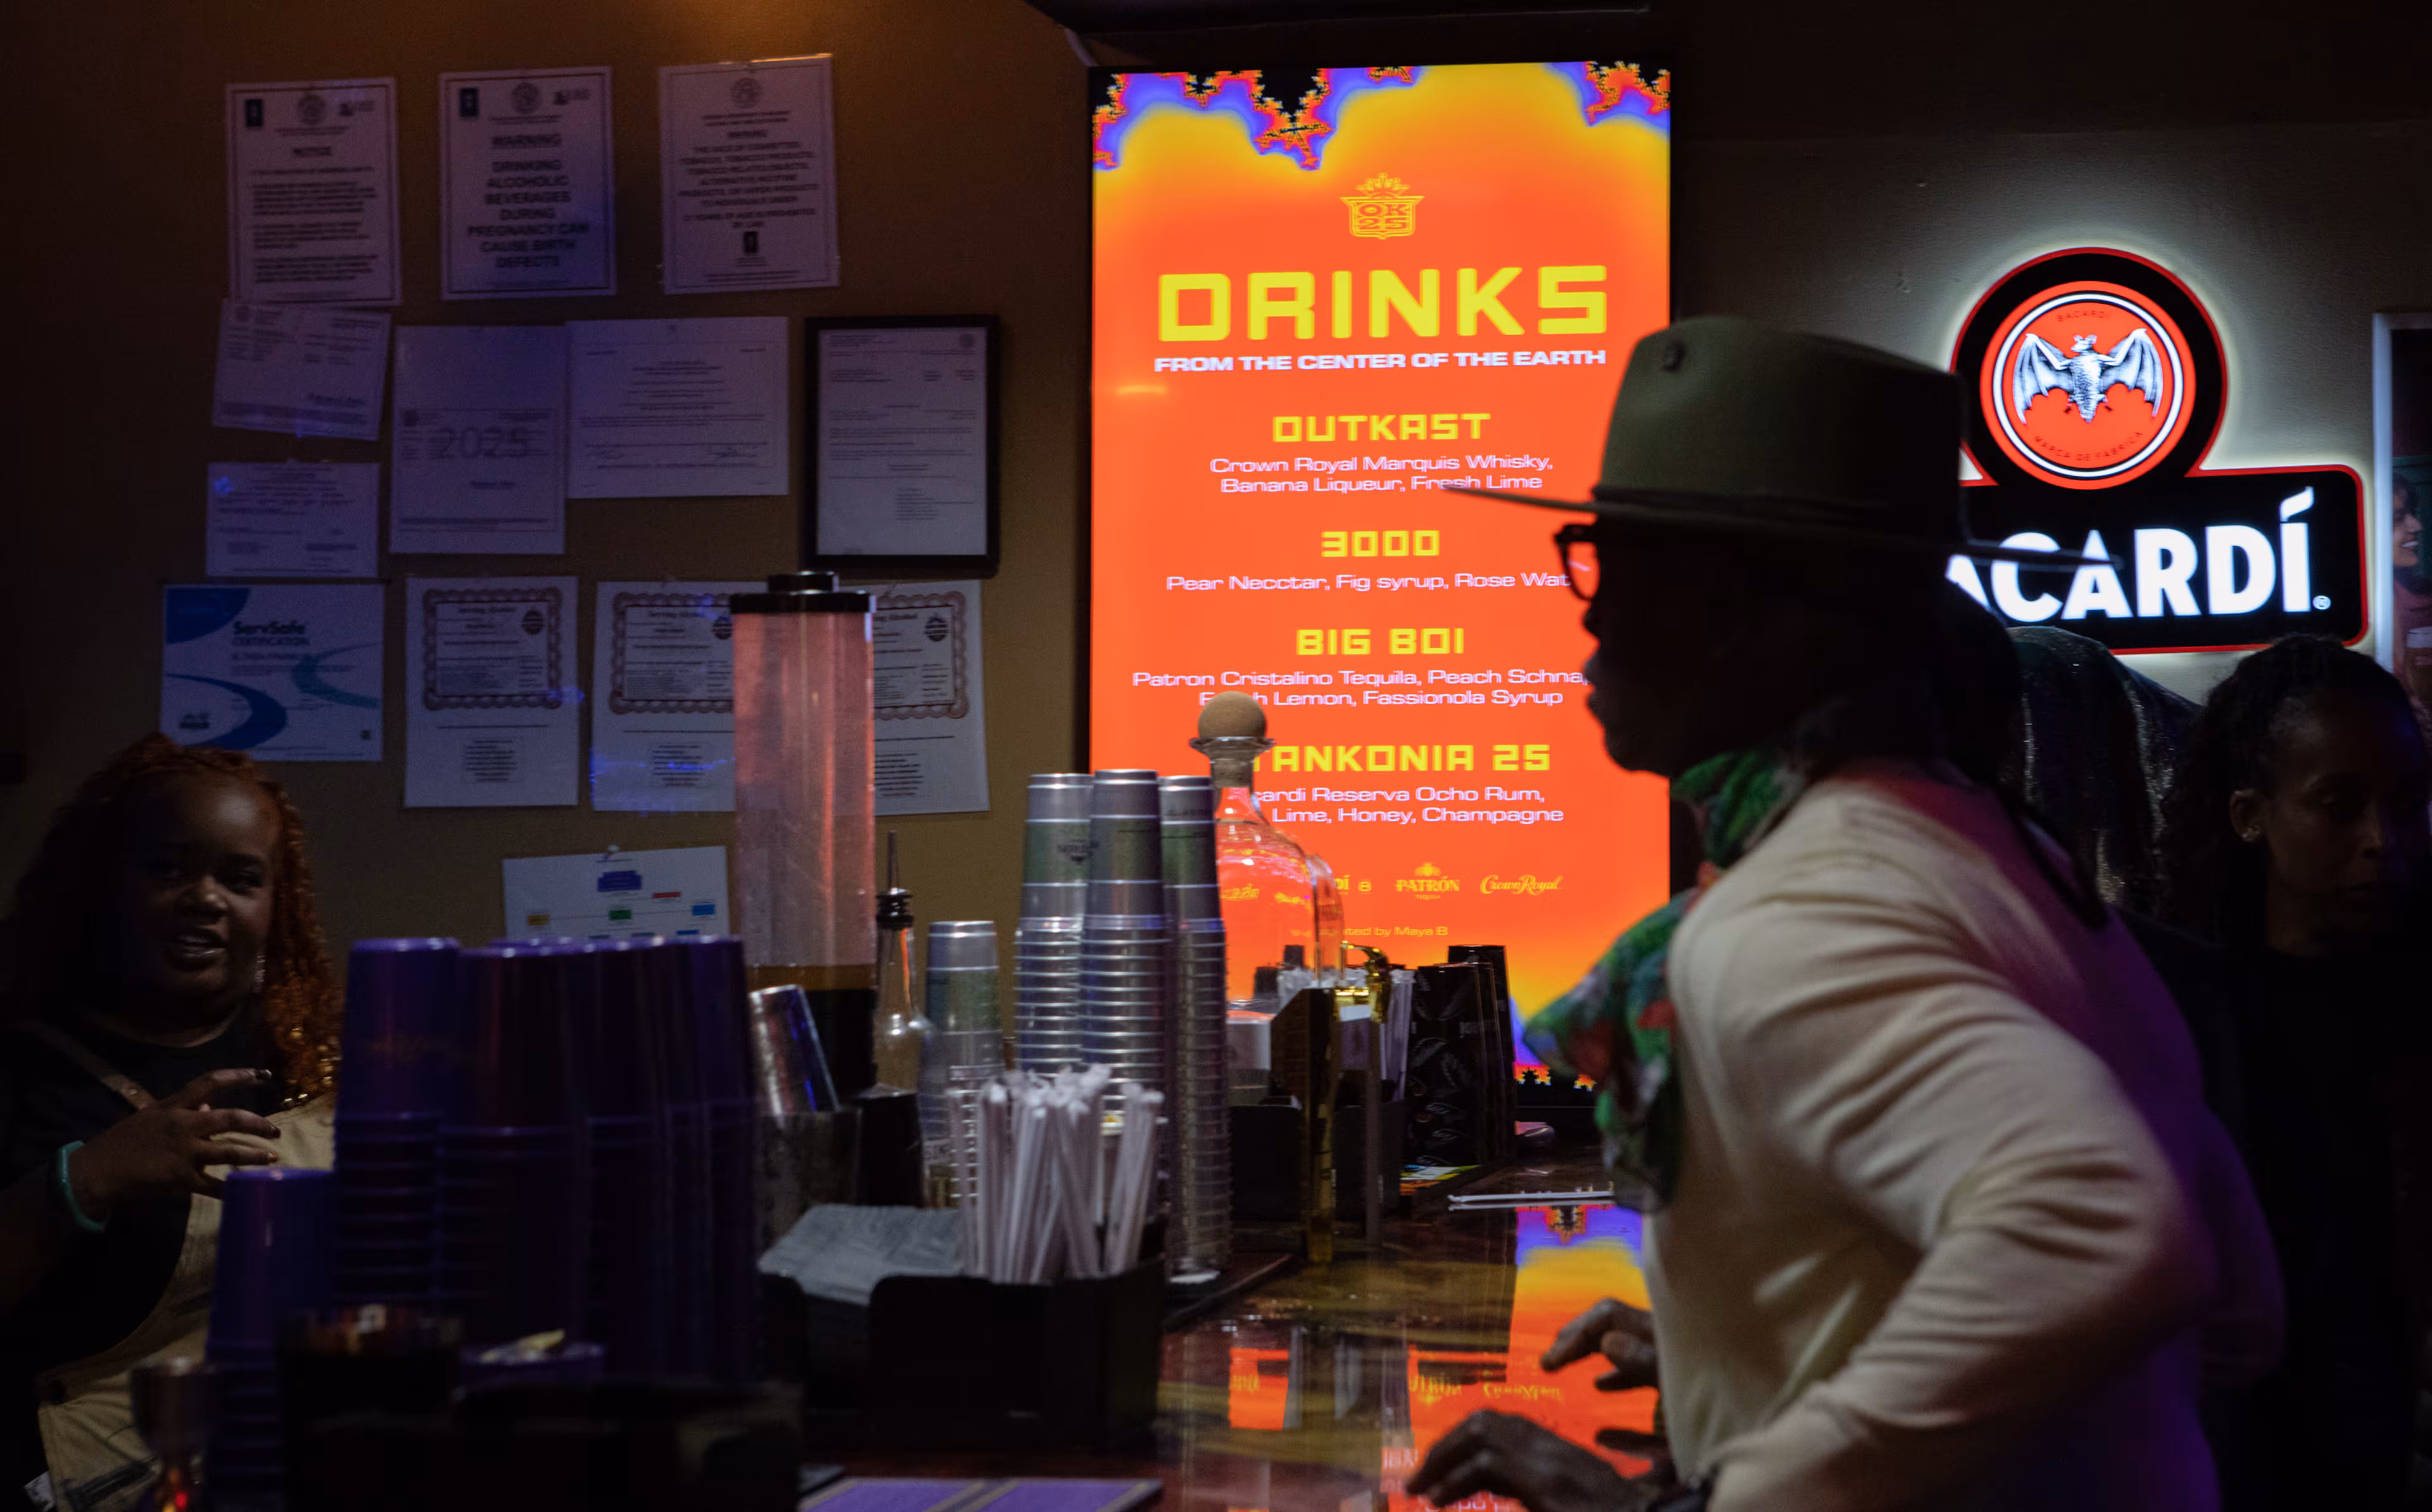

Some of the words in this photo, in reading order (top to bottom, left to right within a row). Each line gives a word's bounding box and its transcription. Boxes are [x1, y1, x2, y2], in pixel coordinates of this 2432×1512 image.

[491, 133, 563, 148] WARNING
[491, 160, 562, 172] DRINKING
[486, 175, 569, 188] ALCOHOLIC
[485, 191, 571, 205] BEVERAGES
[499, 208, 555, 220] DURING
[1359, 203, 1410, 217] OK
[468, 225, 554, 237] PREGNANCY
[557, 223, 590, 234] CAN
[1359, 217, 1408, 230] 25
[481, 241, 528, 253] CAUSE
[533, 239, 577, 251] BIRTH
[496, 255, 561, 268] DEFECTS
[1158, 265, 1607, 343] DRINKS
[1154, 356, 1234, 372] FROM
[1239, 355, 1292, 370] THE
[1297, 354, 1406, 370] CENTER
[1411, 353, 1448, 368] OF
[1454, 351, 1509, 367] THE
[1514, 350, 1607, 366] EARTH
[1273, 412, 1492, 443] OUTKAST
[1210, 458, 1289, 473] Crown
[1294, 457, 1358, 474] Royal
[1362, 455, 1461, 473] Marquis
[1465, 454, 1554, 472] Whisky,
[1220, 478, 1309, 493] Banana
[1313, 477, 1406, 494] Liqueur,
[1410, 476, 1481, 490] Fresh
[1486, 474, 1544, 489] Lime
[1321, 530, 1440, 558] 3000
[1946, 486, 2314, 623] CARDÍ
[1166, 576, 1224, 591] Pear
[1336, 574, 1371, 592] Fig
[1376, 577, 1450, 592] syrup,
[1455, 573, 1516, 588] Rose
[1520, 572, 1571, 587] Wat
[233, 621, 305, 634] ServSafe
[1296, 629, 1371, 656] BIG
[1390, 627, 1464, 655] BOI
[1132, 672, 1215, 687] Patron
[1220, 671, 1333, 686] Cristalino
[1338, 670, 1422, 688] Tequila,
[1428, 669, 1502, 684] Peach
[1507, 668, 1588, 686] Schna
[1273, 691, 1357, 707] Lemon,
[1362, 690, 1486, 705] Fassionola
[1491, 690, 1564, 707] Syrup
[1253, 745, 1474, 772] ANKONIA
[1492, 744, 1550, 771] 25
[1253, 787, 1307, 802] cardi
[1312, 787, 1410, 802] Reserva
[1415, 786, 1479, 802] Ocho
[1484, 786, 1545, 803] Rum,
[1272, 807, 1333, 824] Lime,
[1338, 807, 1417, 825] Honey,
[1422, 807, 1564, 825] Champagne
[1395, 876, 1460, 892] PATRÓN
[1480, 874, 1521, 894] Crown
[1512, 874, 1564, 895] Royal
[1374, 926, 1392, 938] by
[1393, 926, 1434, 938] Maya
